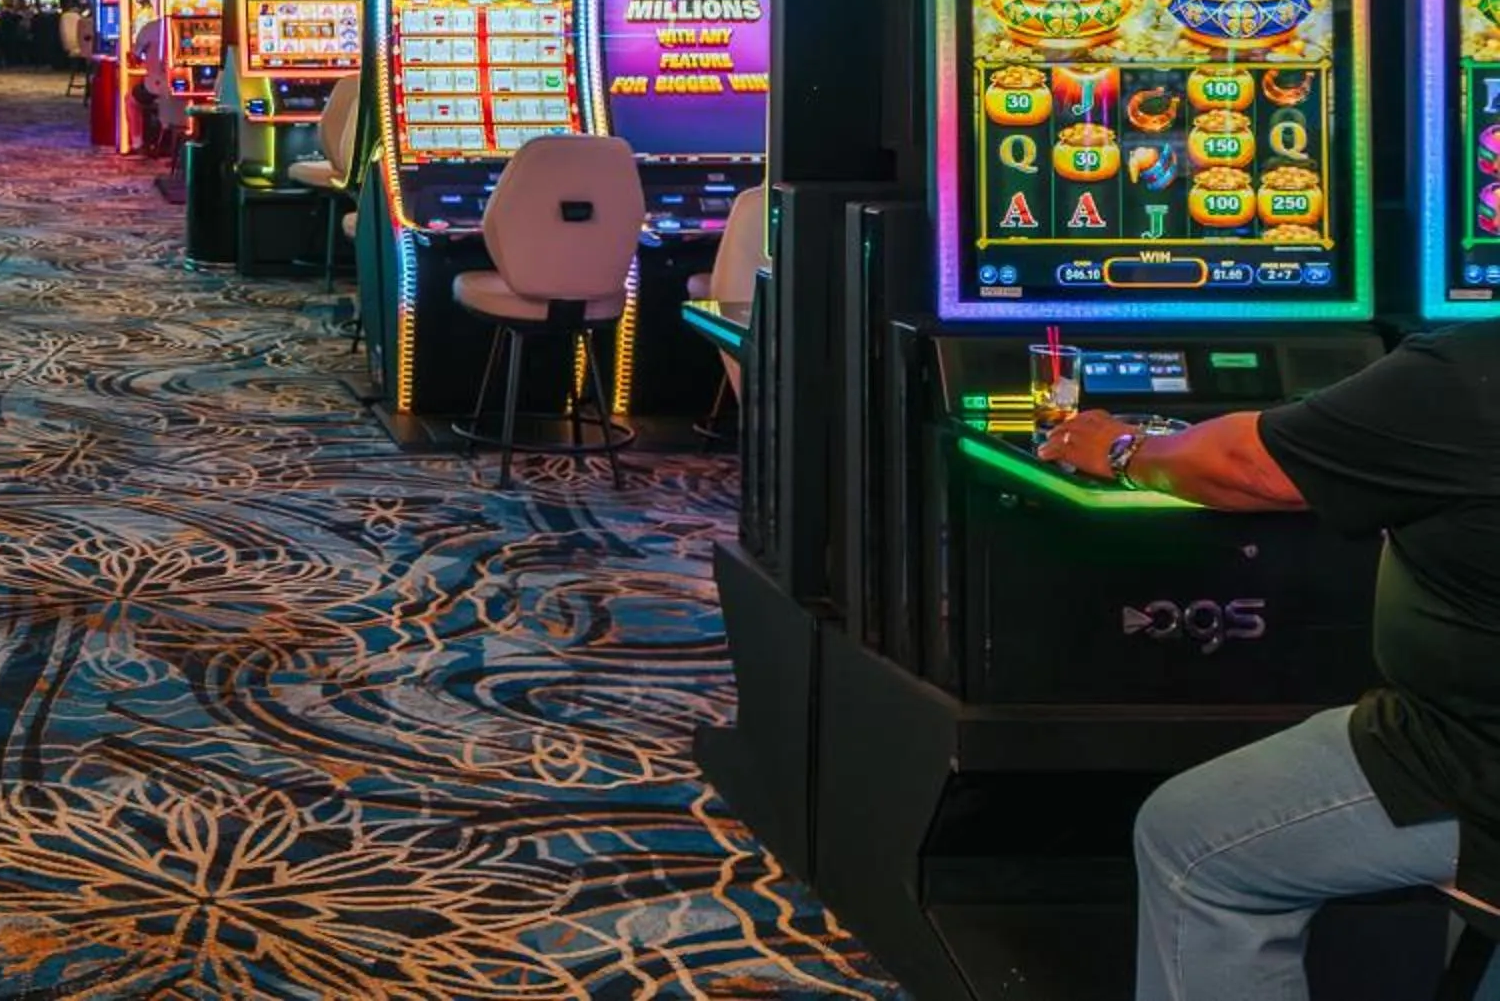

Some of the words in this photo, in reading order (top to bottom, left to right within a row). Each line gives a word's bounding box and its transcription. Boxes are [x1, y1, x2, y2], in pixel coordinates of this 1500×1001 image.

[626, 0, 762, 22] MILLIONS
[657, 28, 696, 46] WITH
[699, 28, 733, 46] ANY
[660, 52, 733, 72] FEATURE
[611, 76, 649, 95] FOR
[655, 74, 723, 94] BIGGER
[1204, 81, 1238, 97] 100
[1006, 94, 1030, 109] 30
[1205, 138, 1239, 154] 150
[1269, 120, 1309, 160] Q
[999, 134, 1038, 173] Q
[1075, 151, 1098, 167] 30
[1000, 191, 1038, 228] A
[1067, 191, 1106, 228] A
[1206, 196, 1240, 211] 100
[1273, 196, 1308, 210] 250
[1140, 250, 1171, 263] WIN
